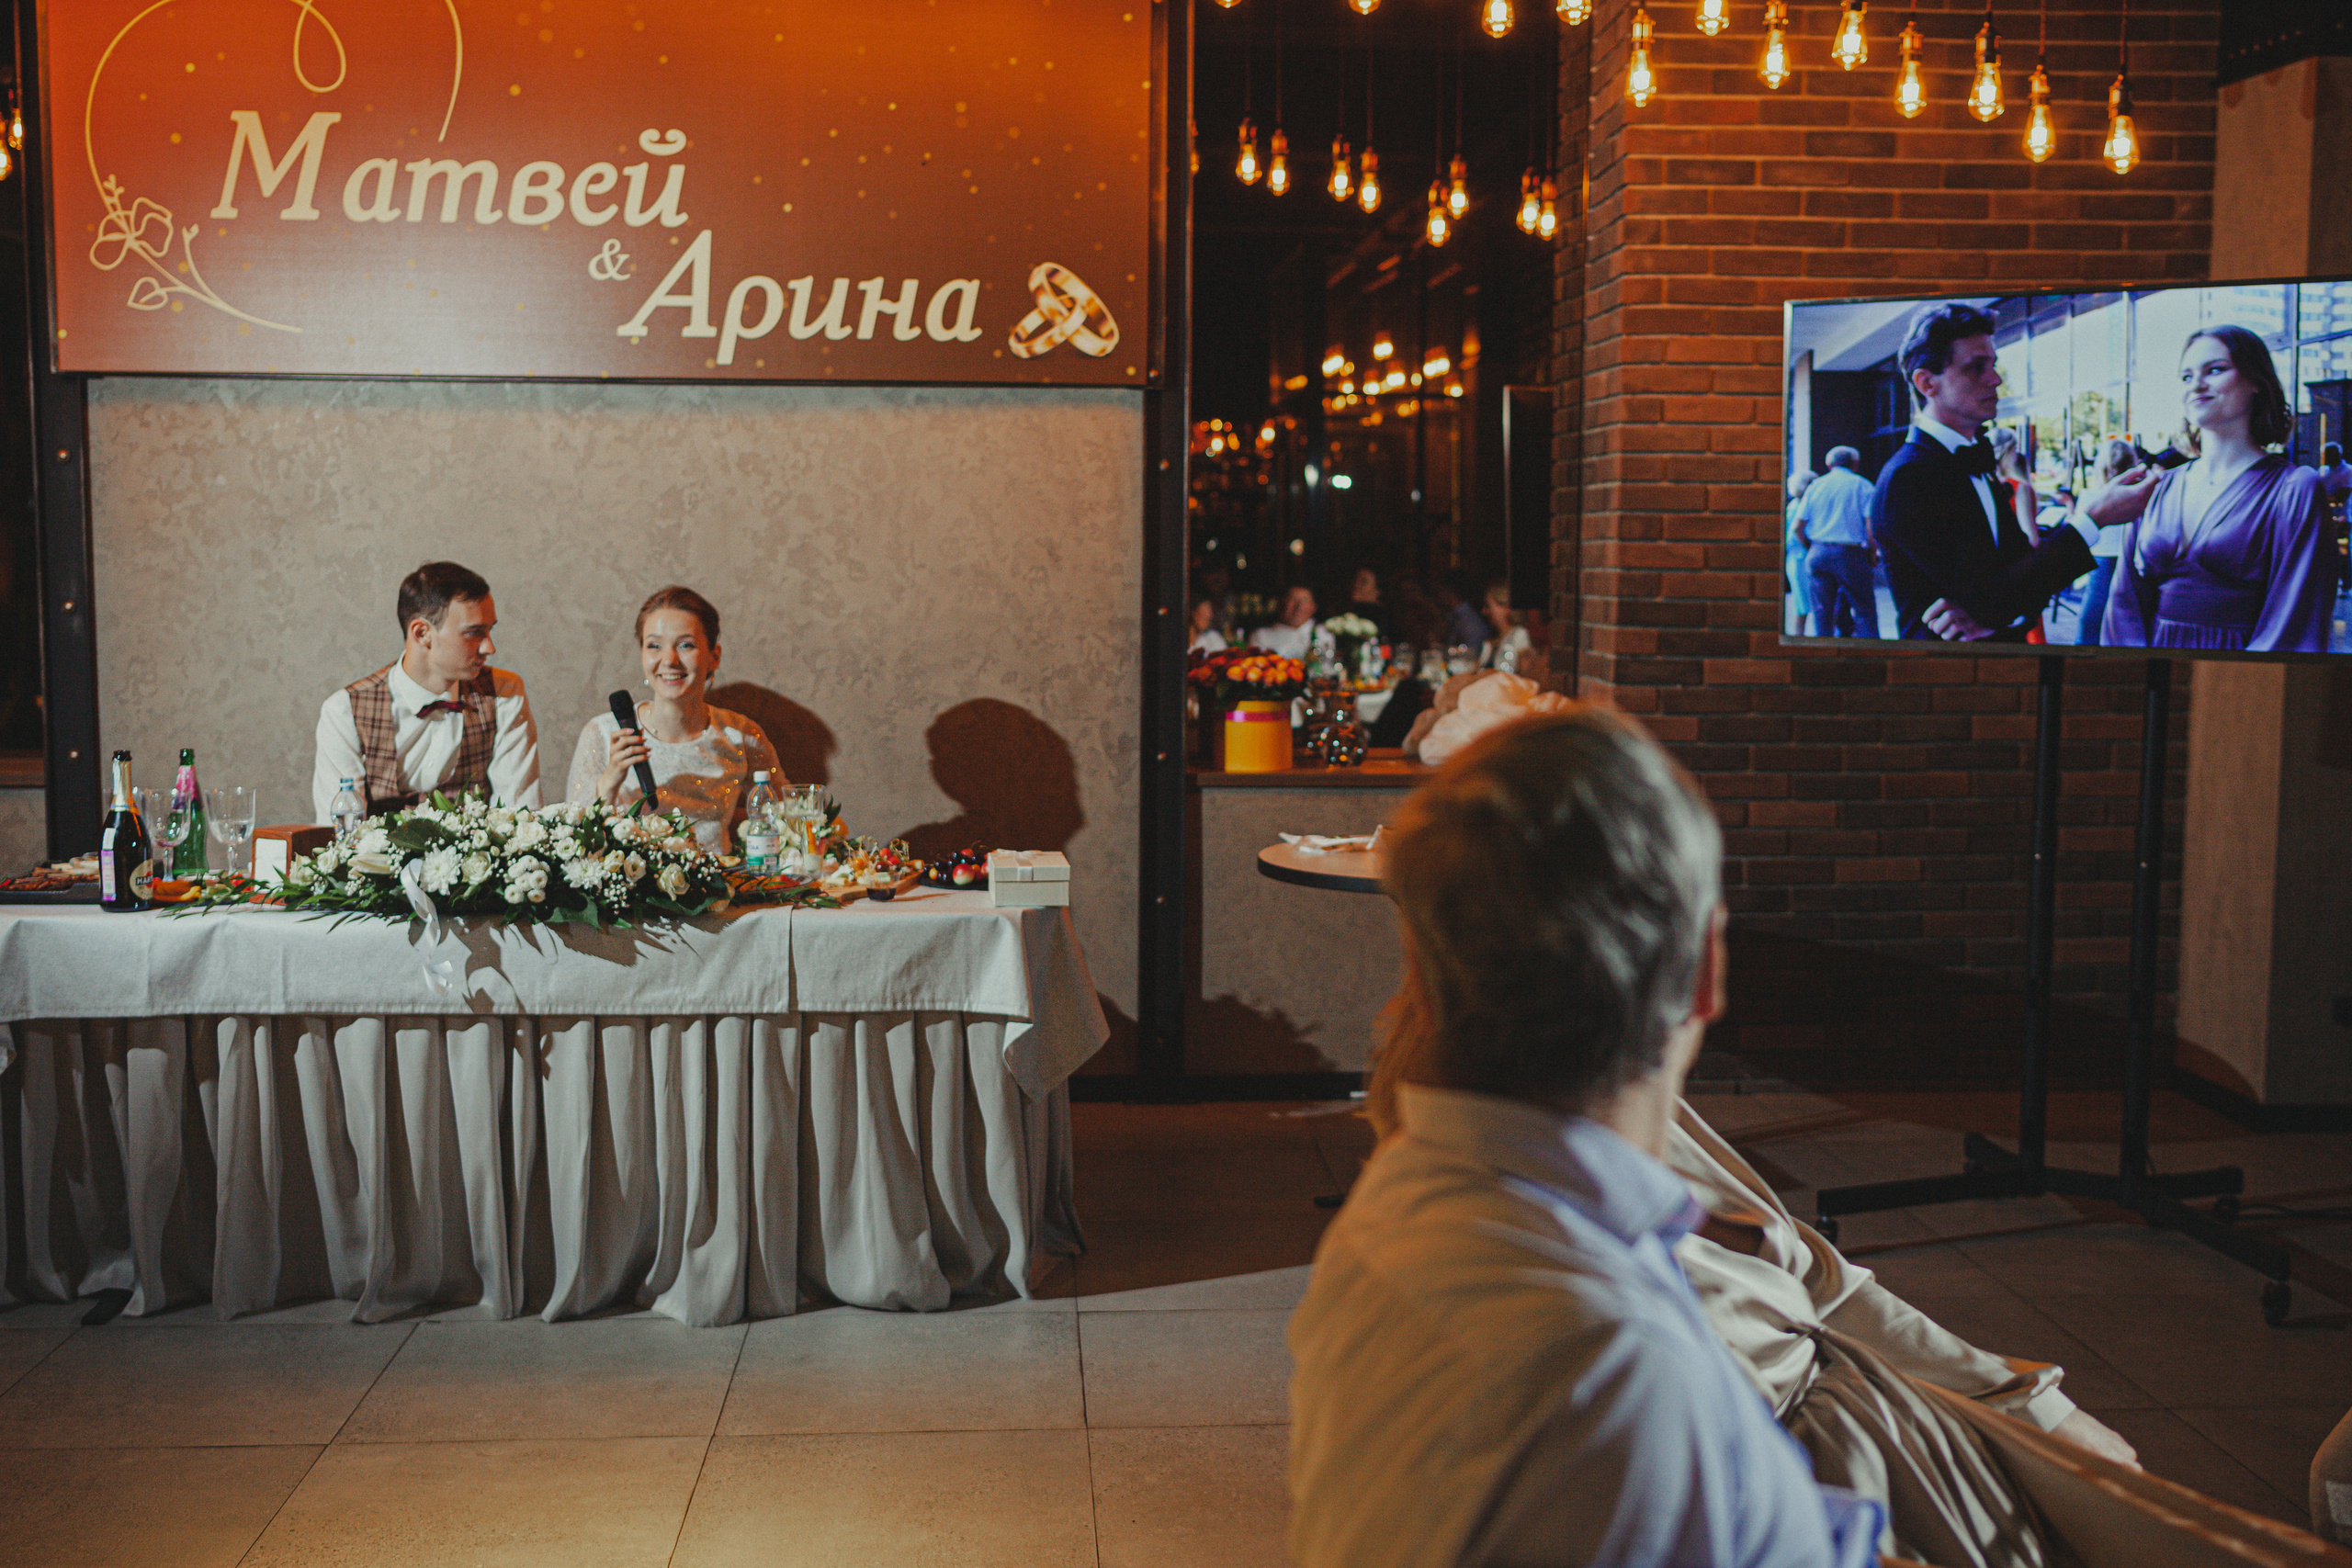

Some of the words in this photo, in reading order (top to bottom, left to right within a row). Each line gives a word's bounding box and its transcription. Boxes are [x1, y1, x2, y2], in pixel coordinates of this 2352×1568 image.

[210, 110, 688, 227] Матвей
[588, 239, 630, 280] &
[616, 230, 982, 365] Арина
